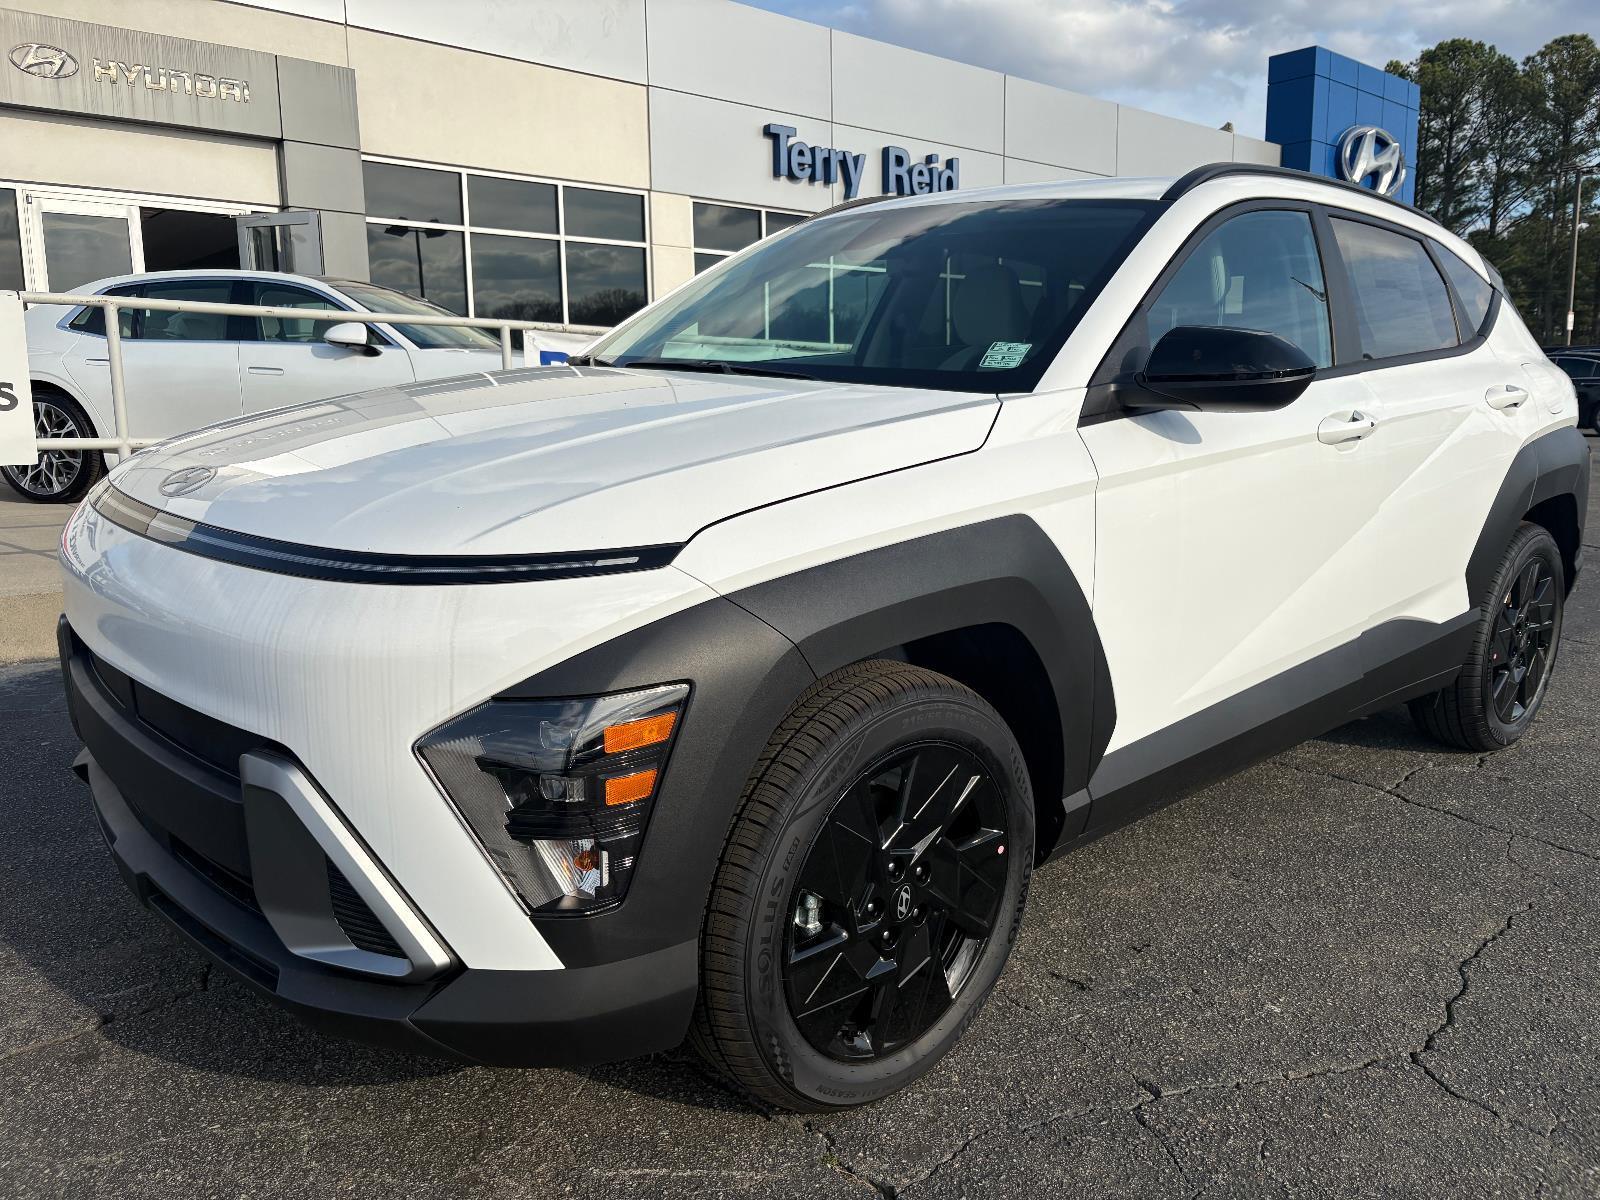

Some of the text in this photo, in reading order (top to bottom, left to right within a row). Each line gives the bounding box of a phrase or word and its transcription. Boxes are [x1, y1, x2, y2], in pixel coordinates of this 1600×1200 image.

[93, 58, 251, 103] HYUNDAI
[763, 123, 959, 199] Terry Reid
[757, 876, 785, 995] SOLUS
